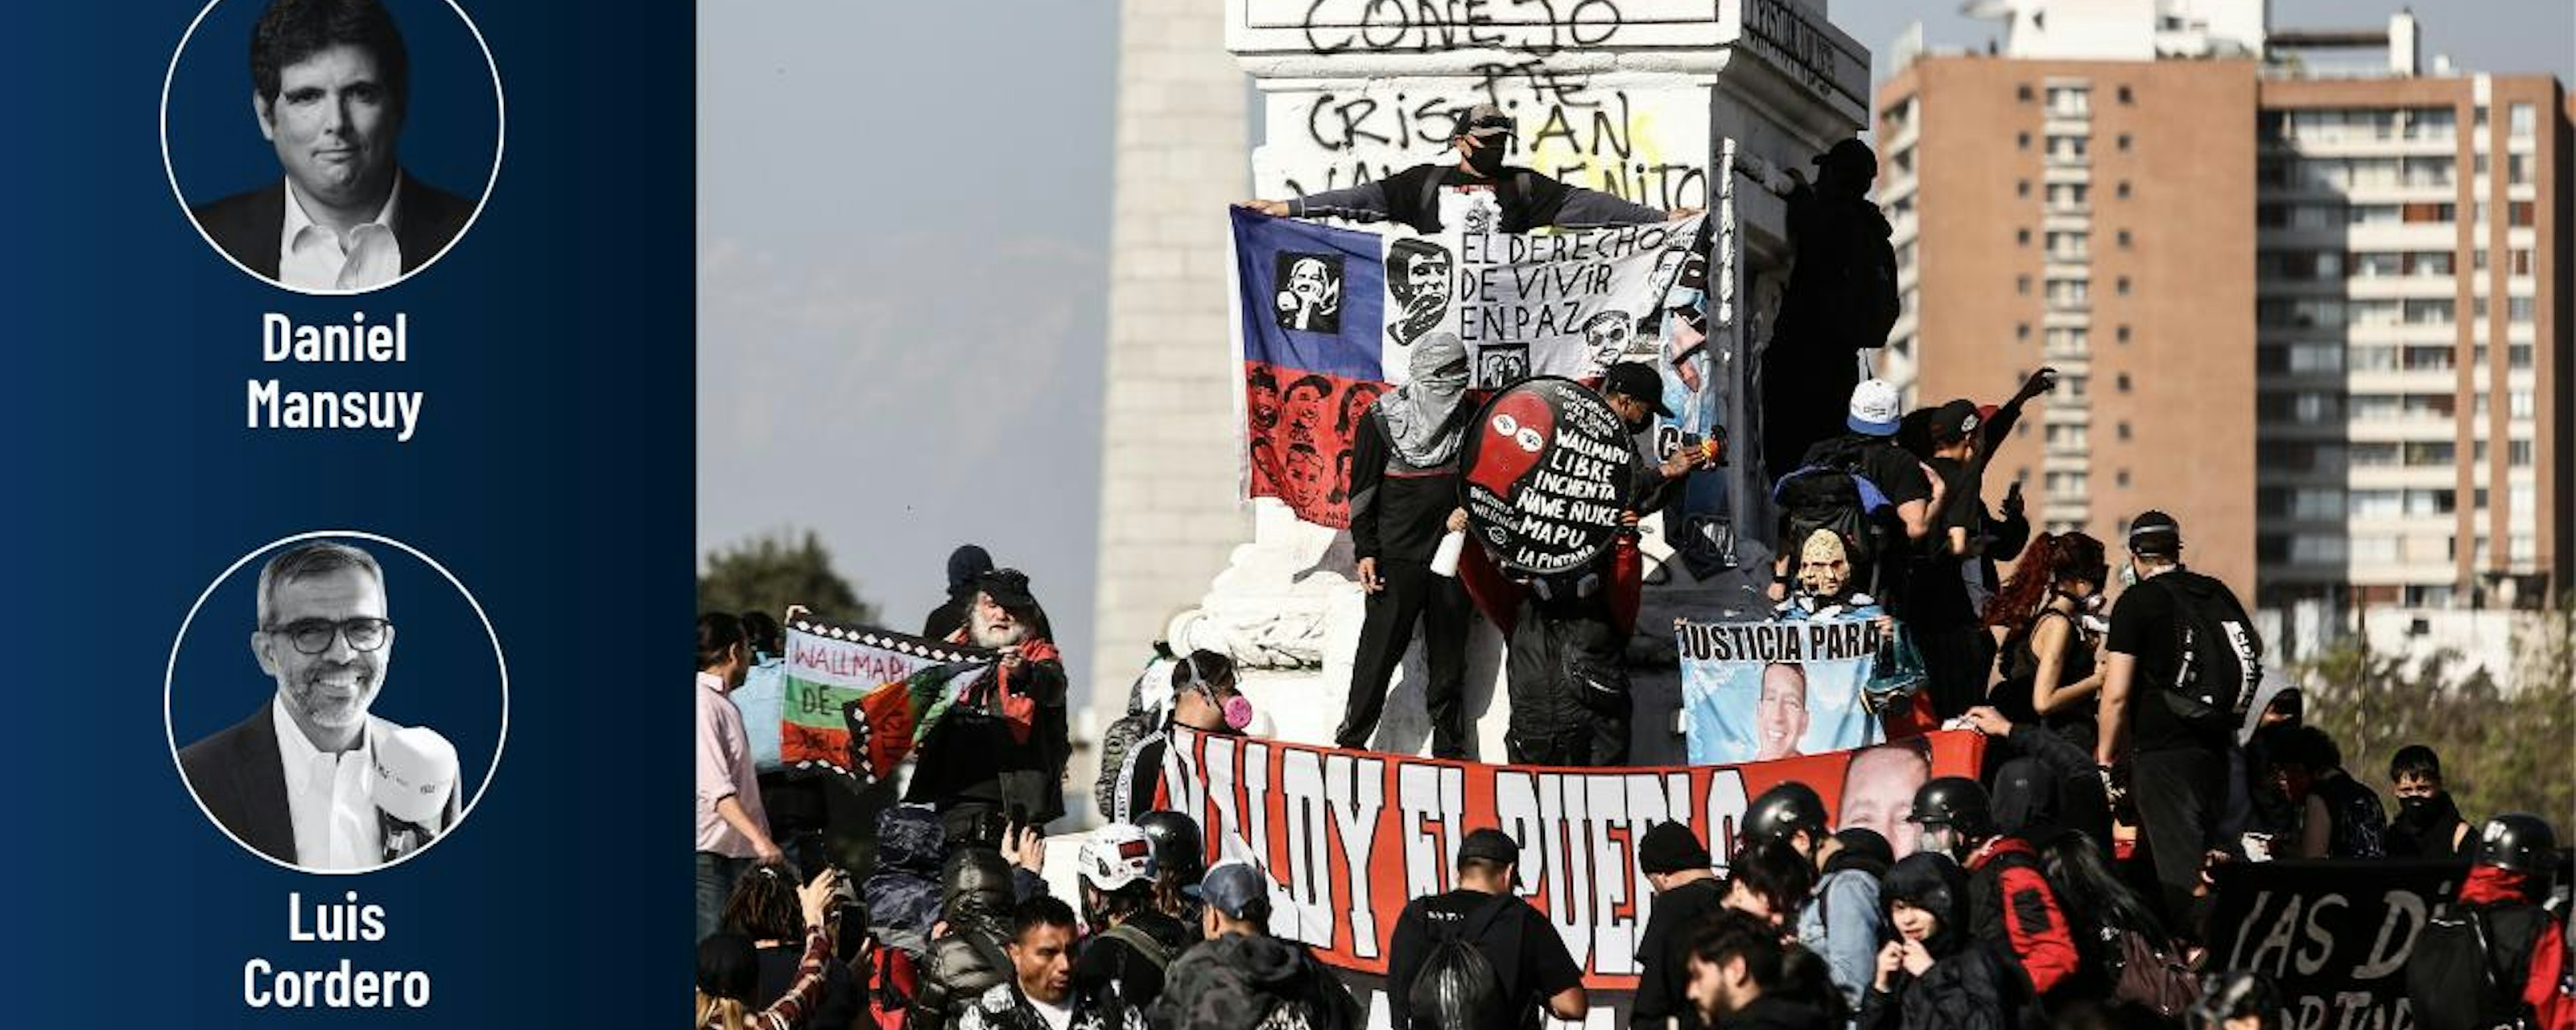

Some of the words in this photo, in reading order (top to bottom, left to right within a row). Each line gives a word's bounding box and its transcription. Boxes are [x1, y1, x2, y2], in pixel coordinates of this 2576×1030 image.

[1463, 232, 1497, 264] EL
[1510, 226, 1666, 264] DERECHO
[1461, 268, 1497, 302] DE
[1556, 426, 1629, 464] WALLMAPU
[1550, 447, 1614, 482] LIBRE
[1519, 515, 1587, 549] MAPU
[1517, 546, 1534, 566] LA
[1681, 624, 1802, 660] JUSTICIA
[1811, 620, 1880, 660] PARA
